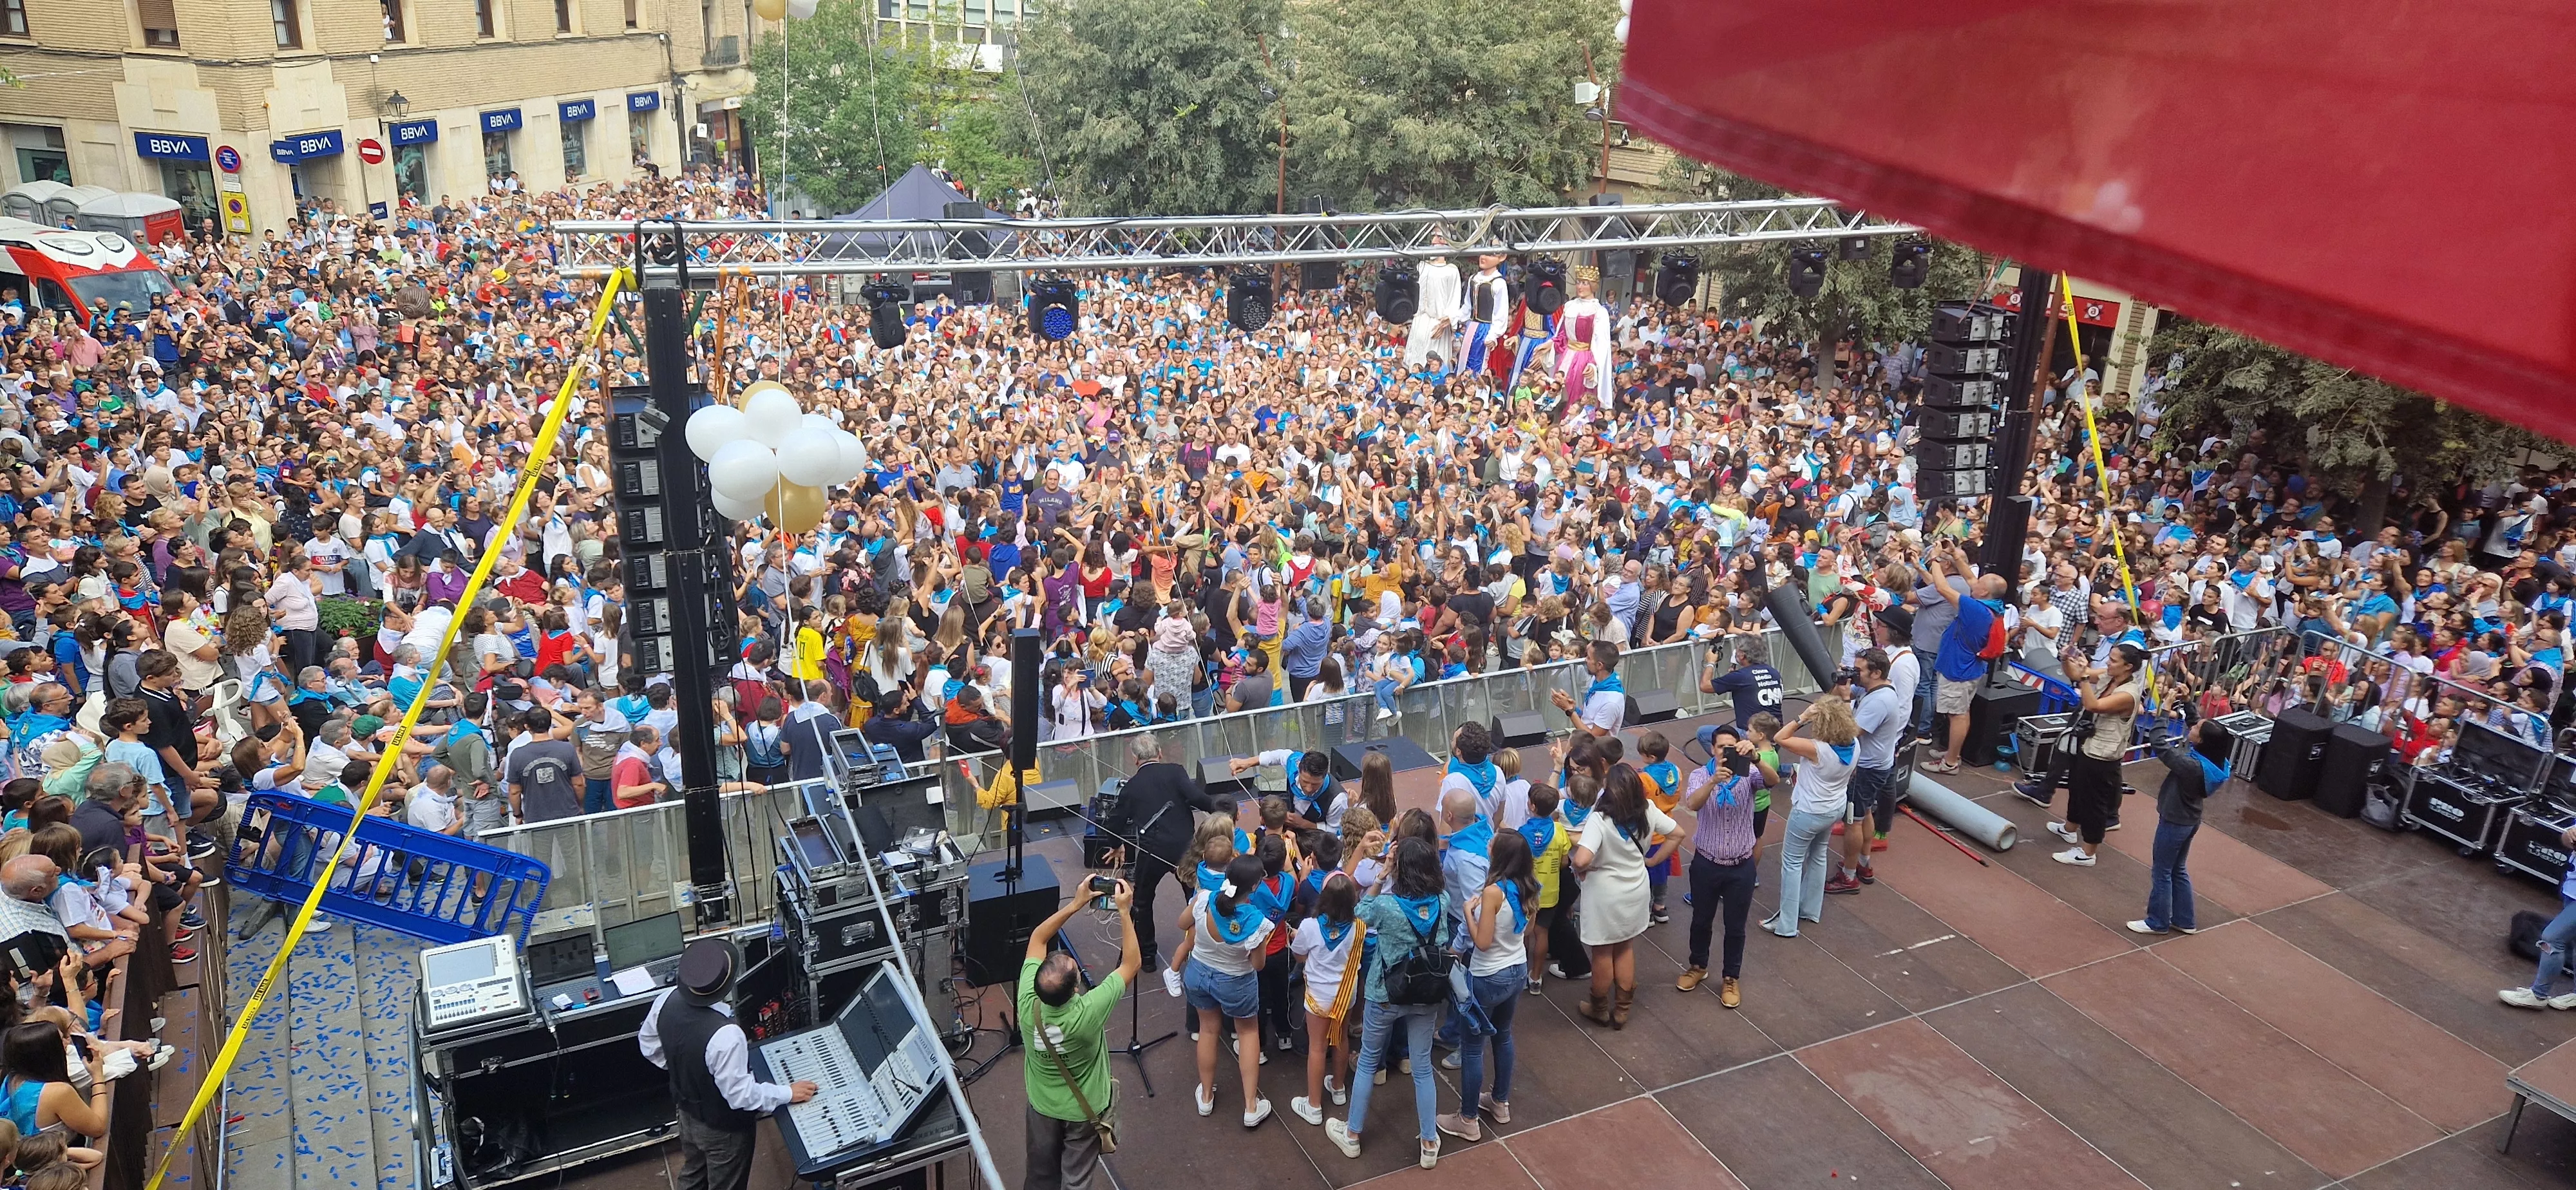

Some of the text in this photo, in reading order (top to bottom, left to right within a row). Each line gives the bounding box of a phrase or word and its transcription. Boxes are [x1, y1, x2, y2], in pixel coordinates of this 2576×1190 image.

[634, 95, 653, 108] BBVA
[567, 103, 588, 117] BBVA
[490, 113, 514, 128] BBVA
[401, 124, 428, 140] BBVA
[150, 139, 191, 154] BBVA
[299, 135, 332, 153] BBVA
[392, 726, 407, 746] ULINE
